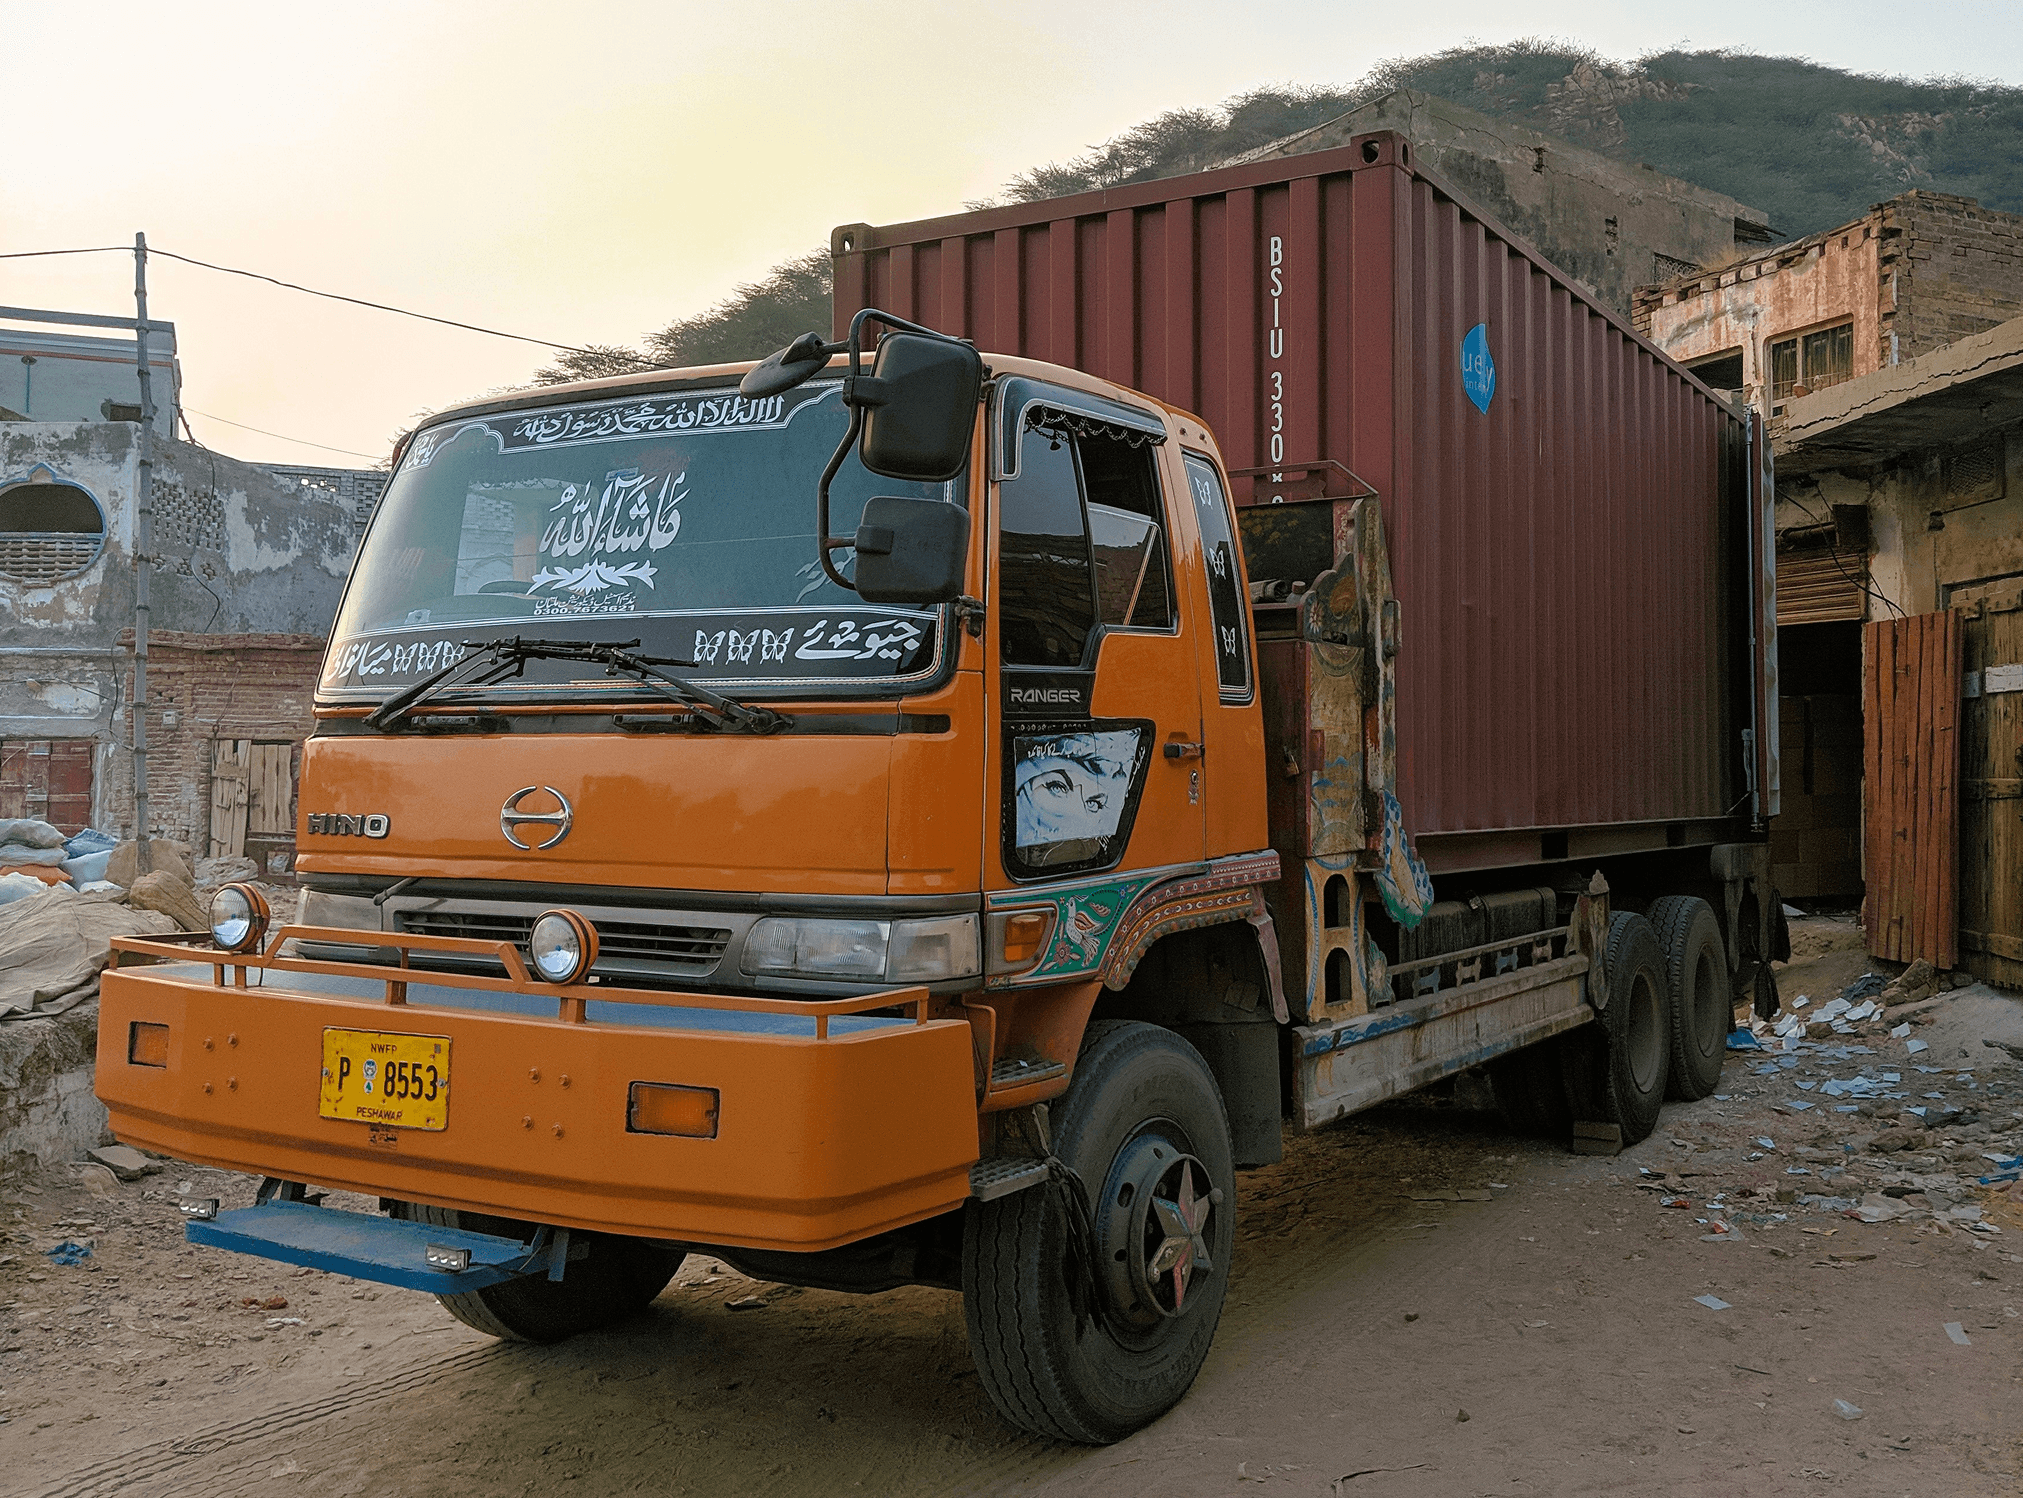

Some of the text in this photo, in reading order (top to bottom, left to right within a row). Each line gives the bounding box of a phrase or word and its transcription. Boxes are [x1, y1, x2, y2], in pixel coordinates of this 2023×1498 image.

[1269, 236, 1284, 359] BSIU
[1010, 688, 1081, 703] RANGER
[307, 812, 390, 838] HINO
[370, 1043, 398, 1054] NWFP
[338, 1056, 439, 1102] P 8553
[356, 1105, 404, 1121] PESHAWAR
